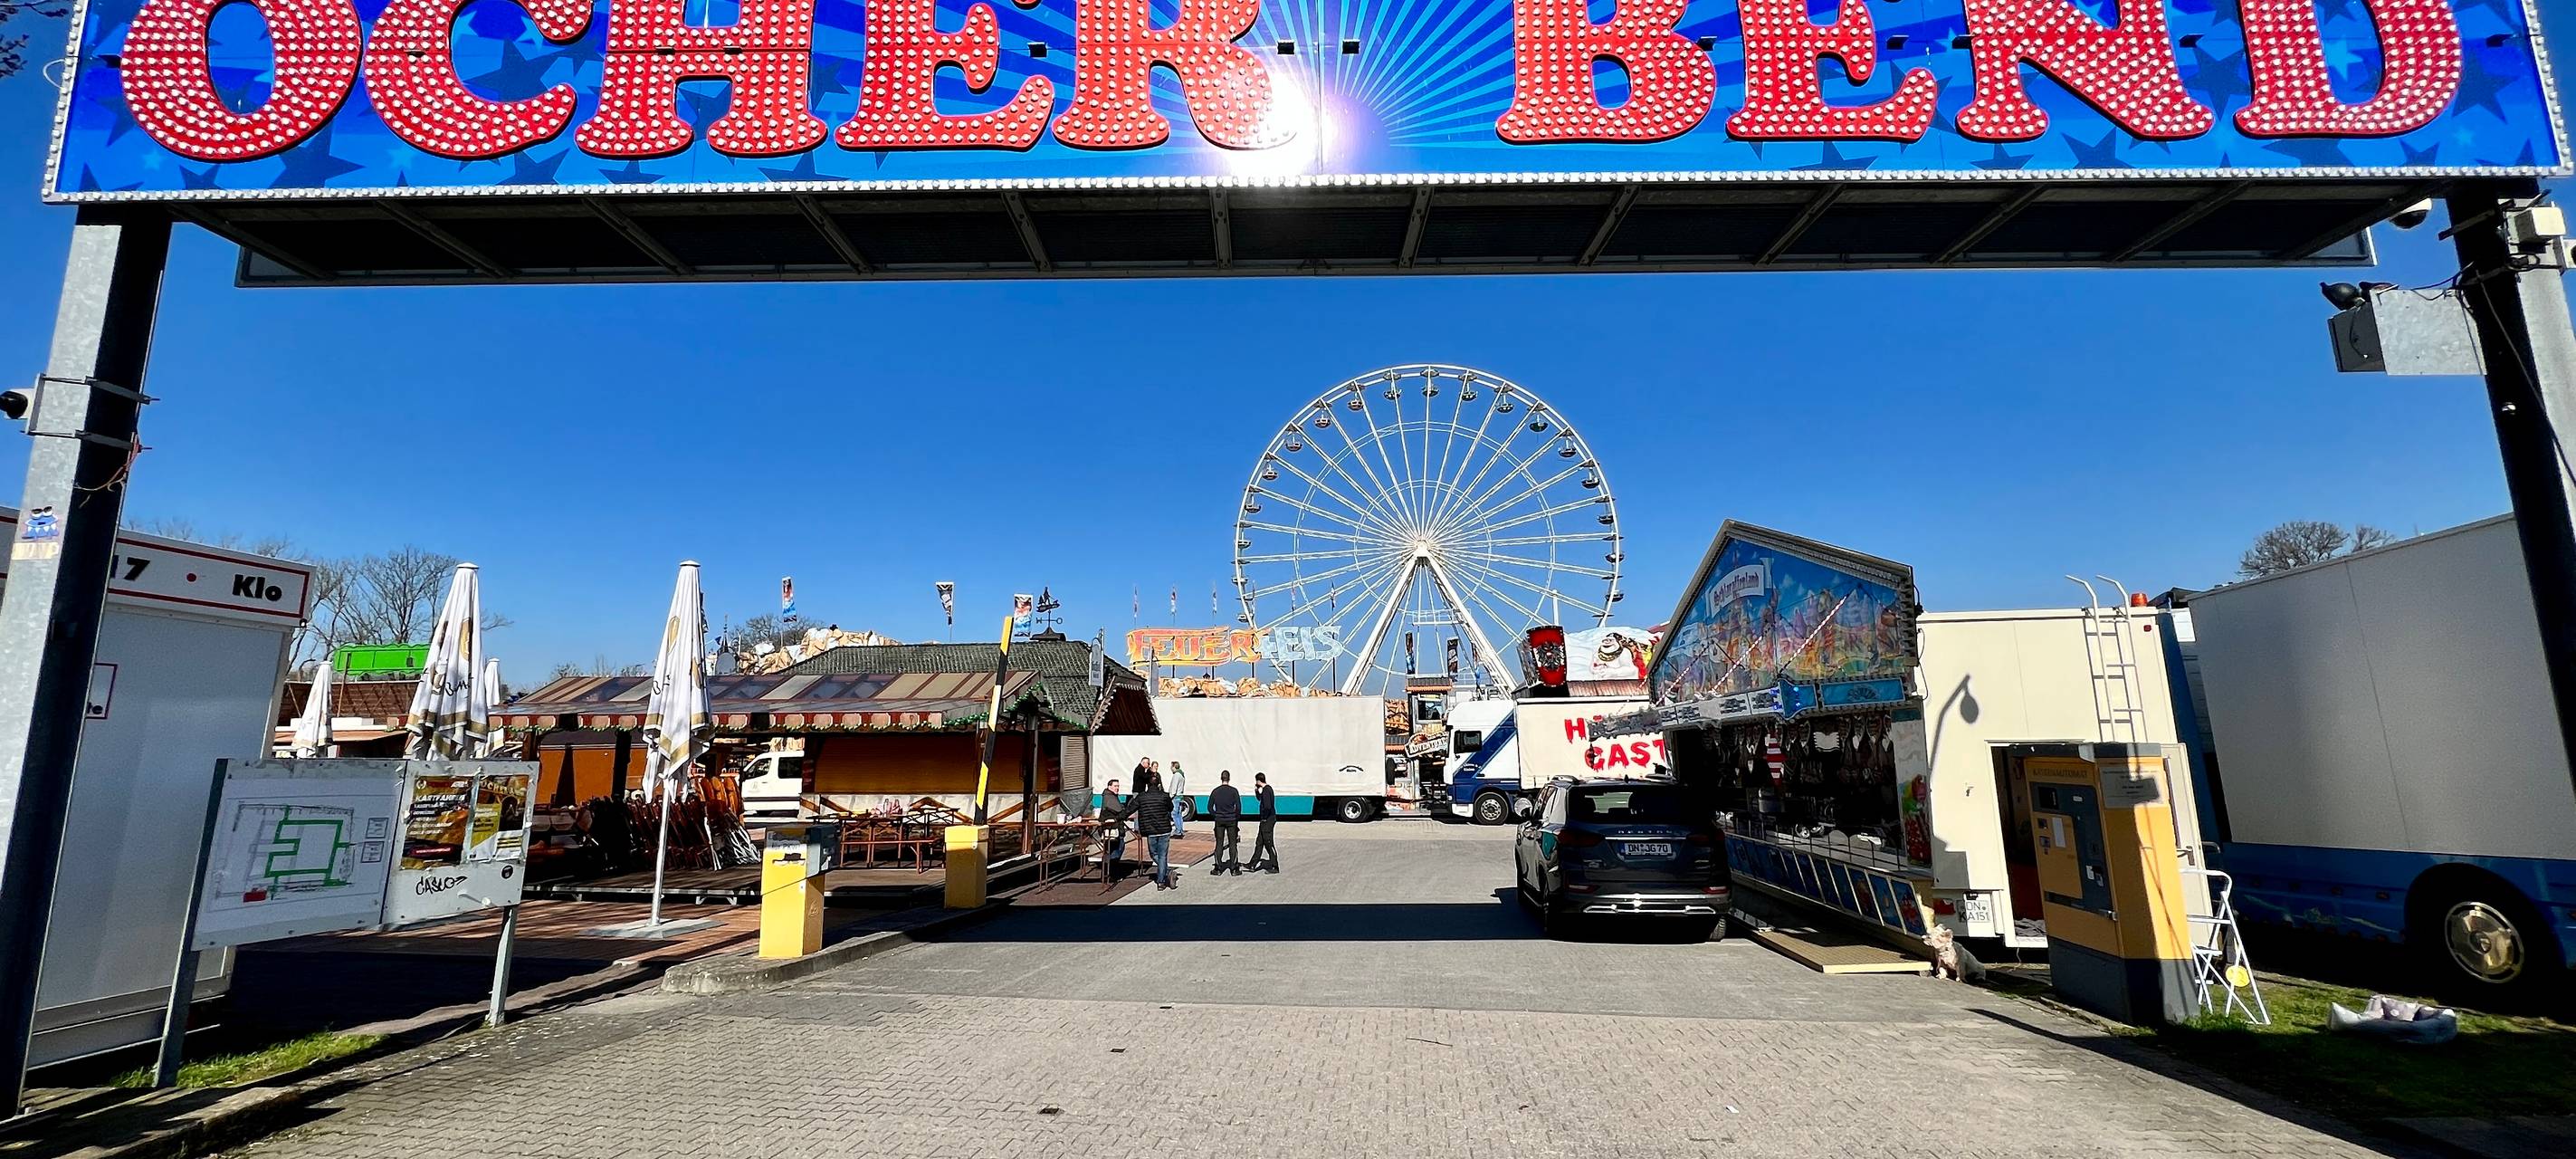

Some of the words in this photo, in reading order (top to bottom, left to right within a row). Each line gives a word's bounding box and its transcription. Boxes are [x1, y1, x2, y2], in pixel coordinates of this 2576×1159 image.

[1495, 0, 2463, 144] BEND
[233, 574, 282, 601] Klo
[1127, 627, 1267, 666] FEUER
[1274, 626, 1343, 661] EIS
[1628, 844, 1639, 852] DN
[1965, 901, 1981, 911] DN
